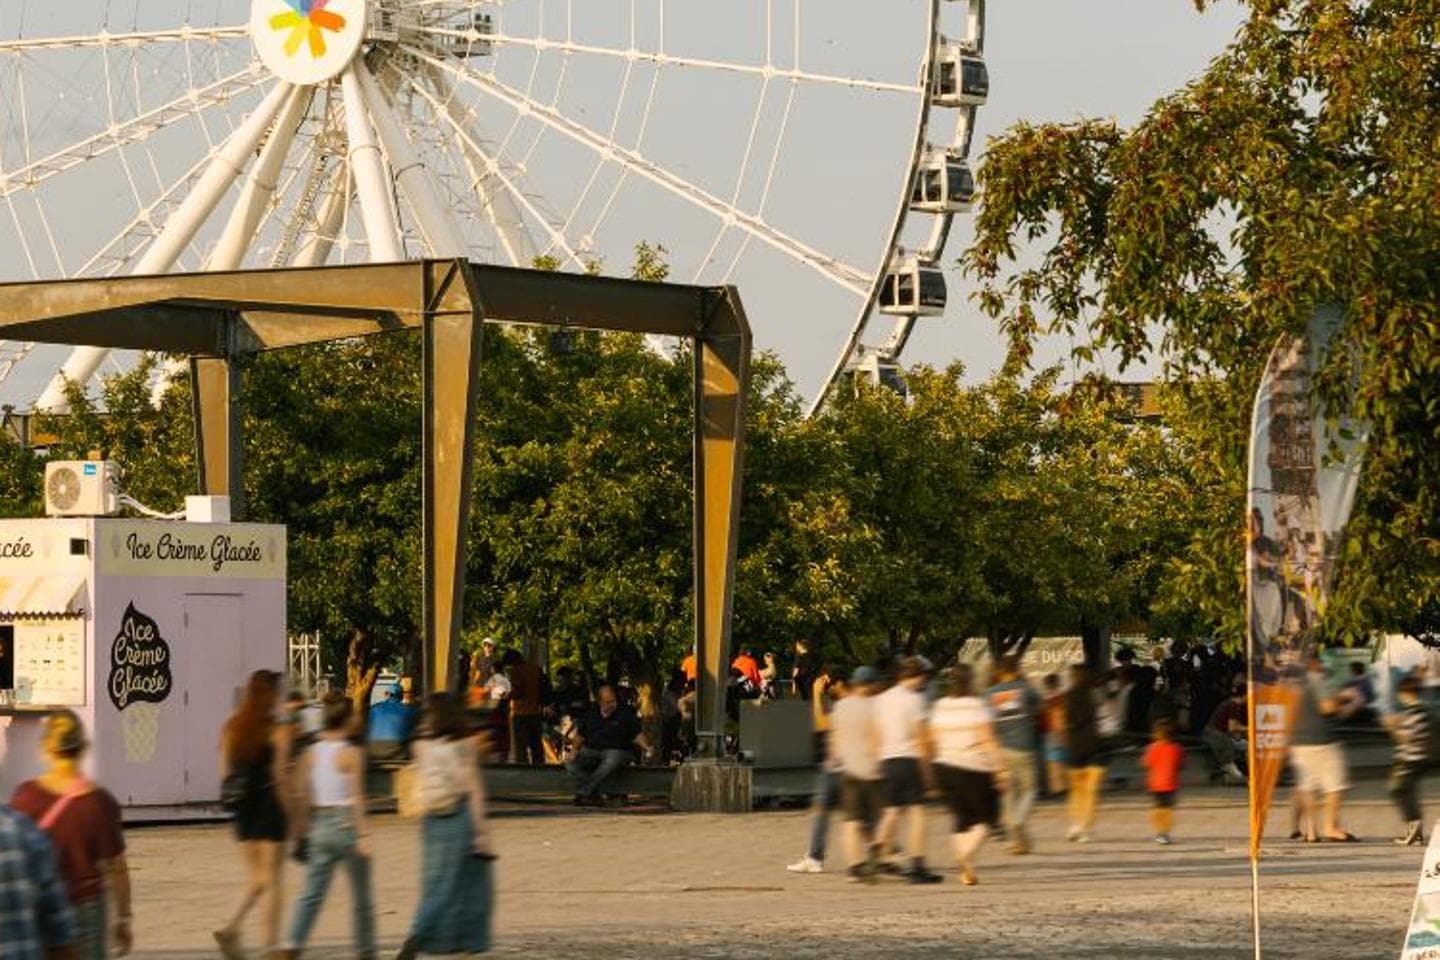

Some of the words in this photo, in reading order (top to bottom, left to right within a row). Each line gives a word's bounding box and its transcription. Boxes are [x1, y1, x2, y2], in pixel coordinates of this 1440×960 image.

[126, 533, 154, 560] Ice
[157, 533, 208, 561] Crème
[210, 534, 262, 572] Glacée
[124, 617, 155, 641] Ice
[114, 636, 166, 666] Crème
[112, 666, 168, 707] Glacée
